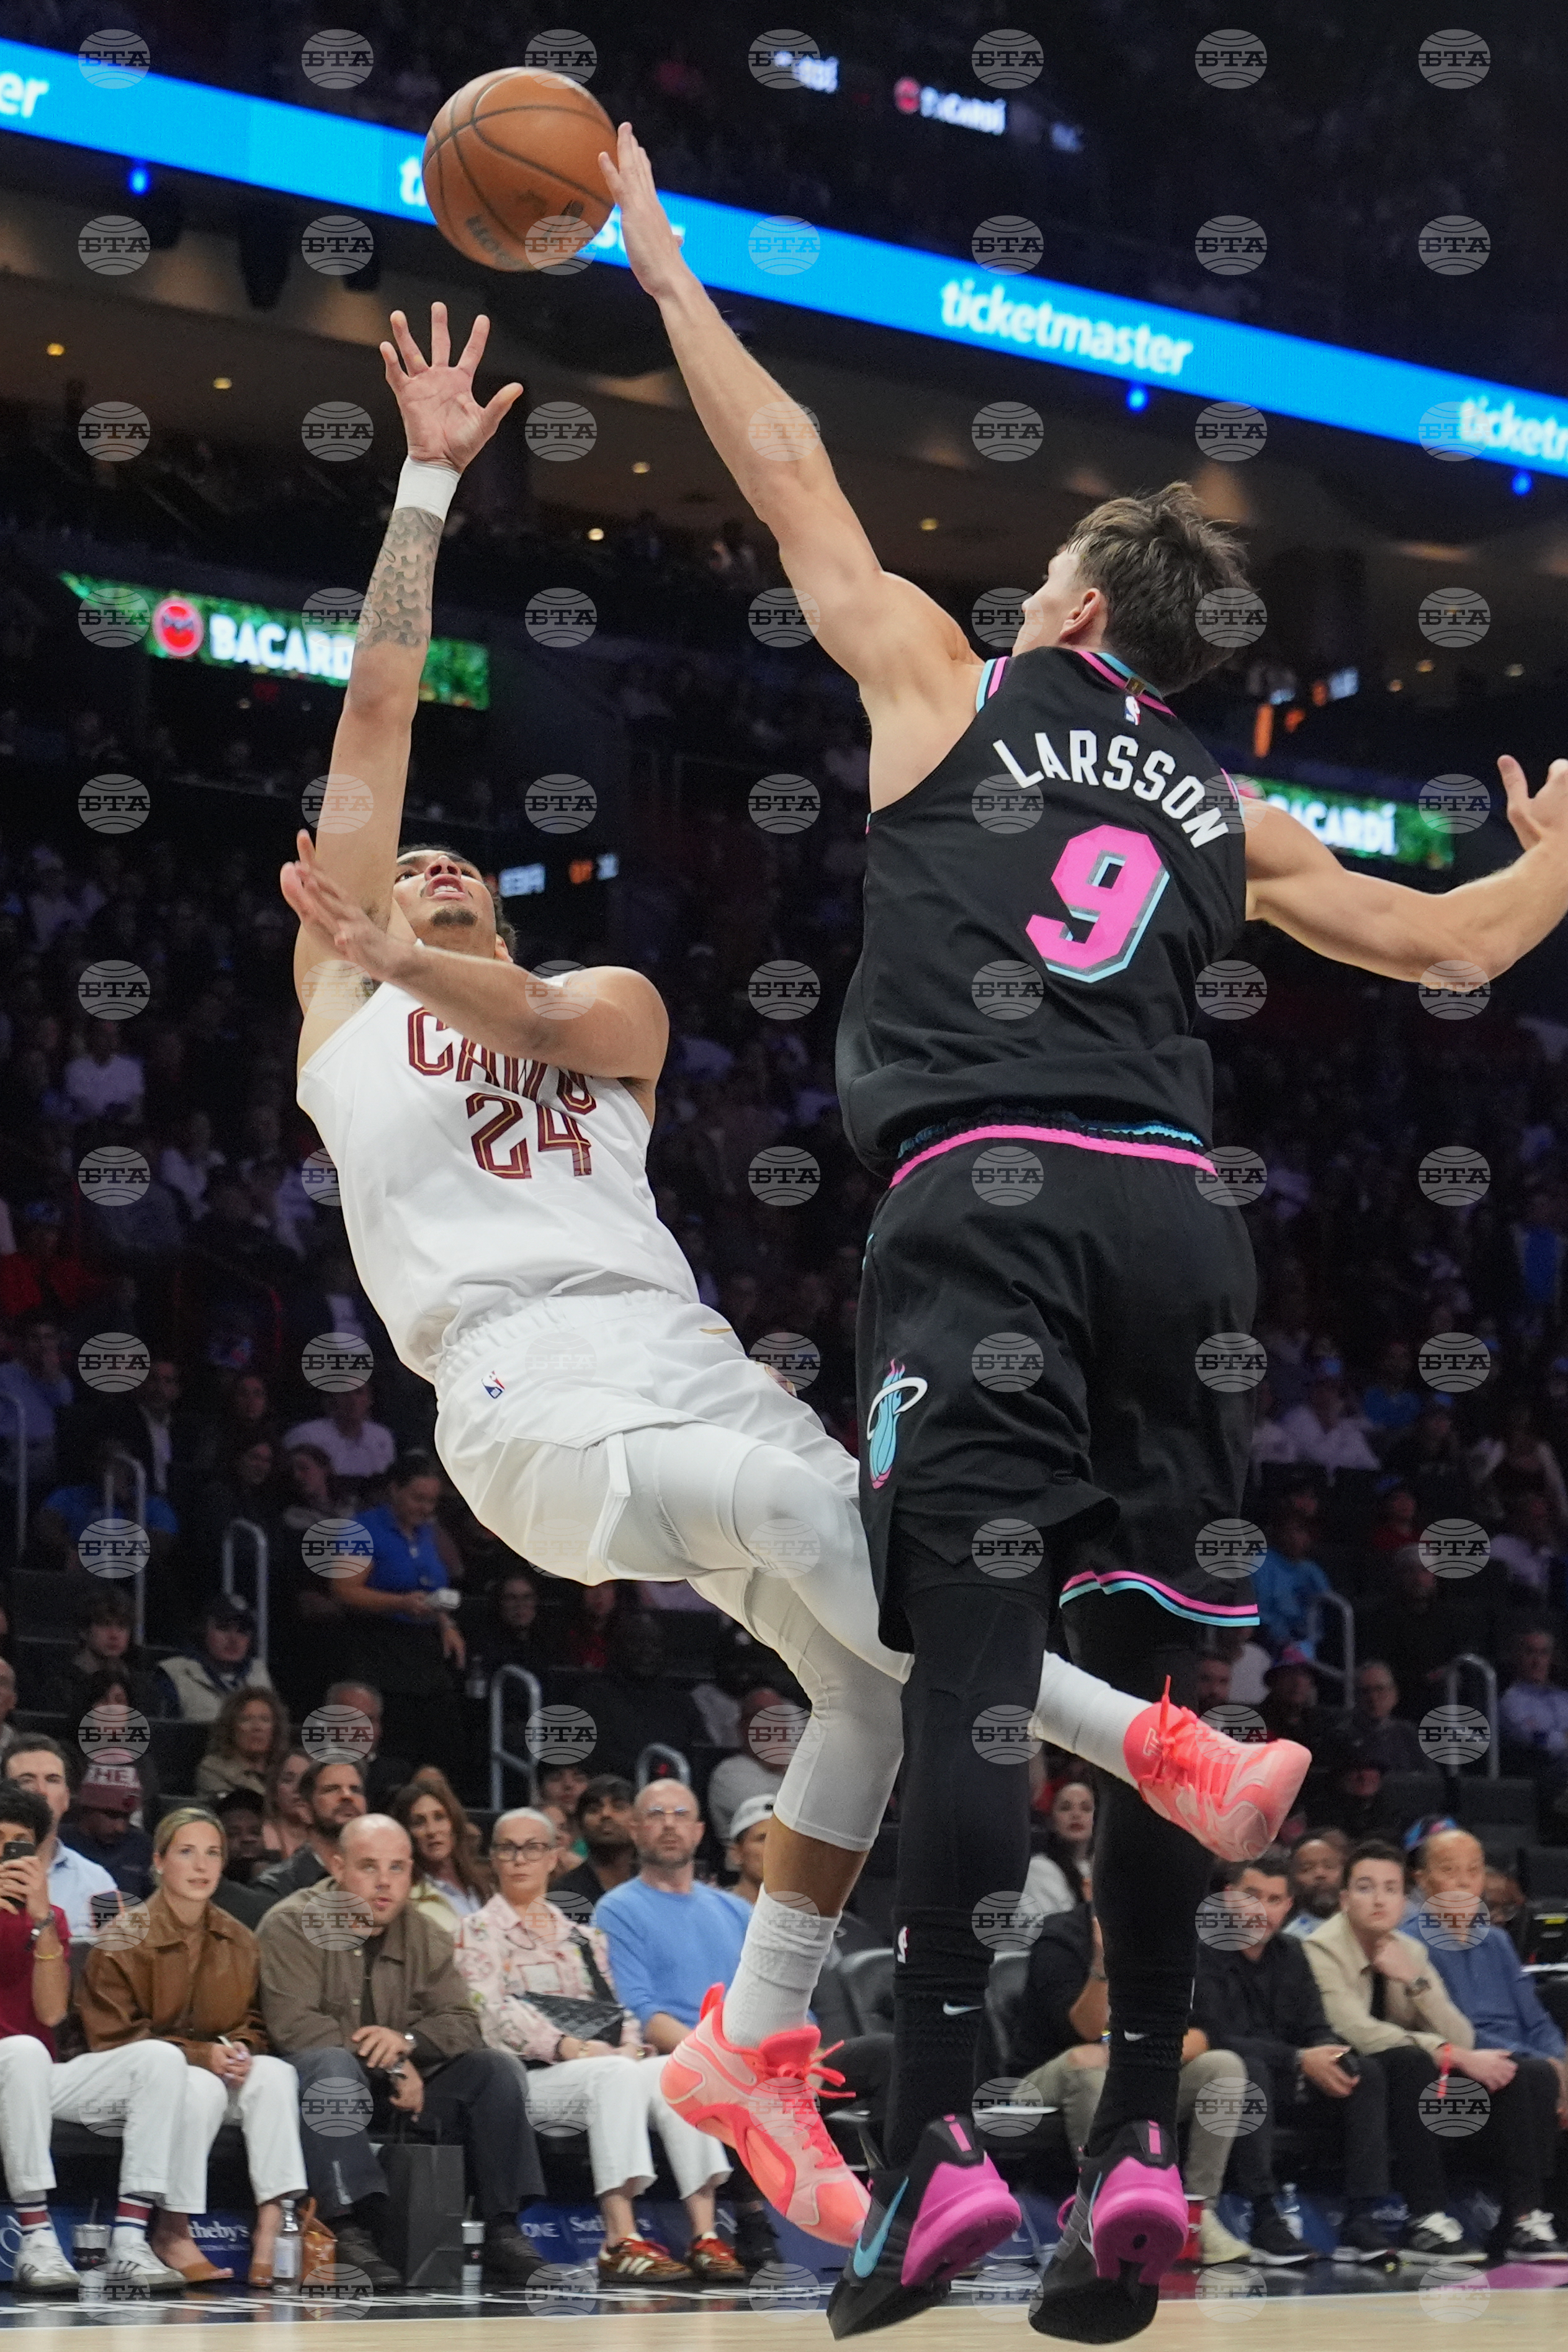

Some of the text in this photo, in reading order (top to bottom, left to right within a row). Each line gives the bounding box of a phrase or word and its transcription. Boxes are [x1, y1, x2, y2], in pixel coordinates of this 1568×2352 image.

[941, 277, 1194, 375] ticketmaster
[1459, 395, 1568, 462] ticket
[210, 613, 358, 681] BACARD
[993, 730, 1229, 848] LARSSON
[1025, 824, 1170, 984] 9
[465, 1092, 592, 1179] 24
